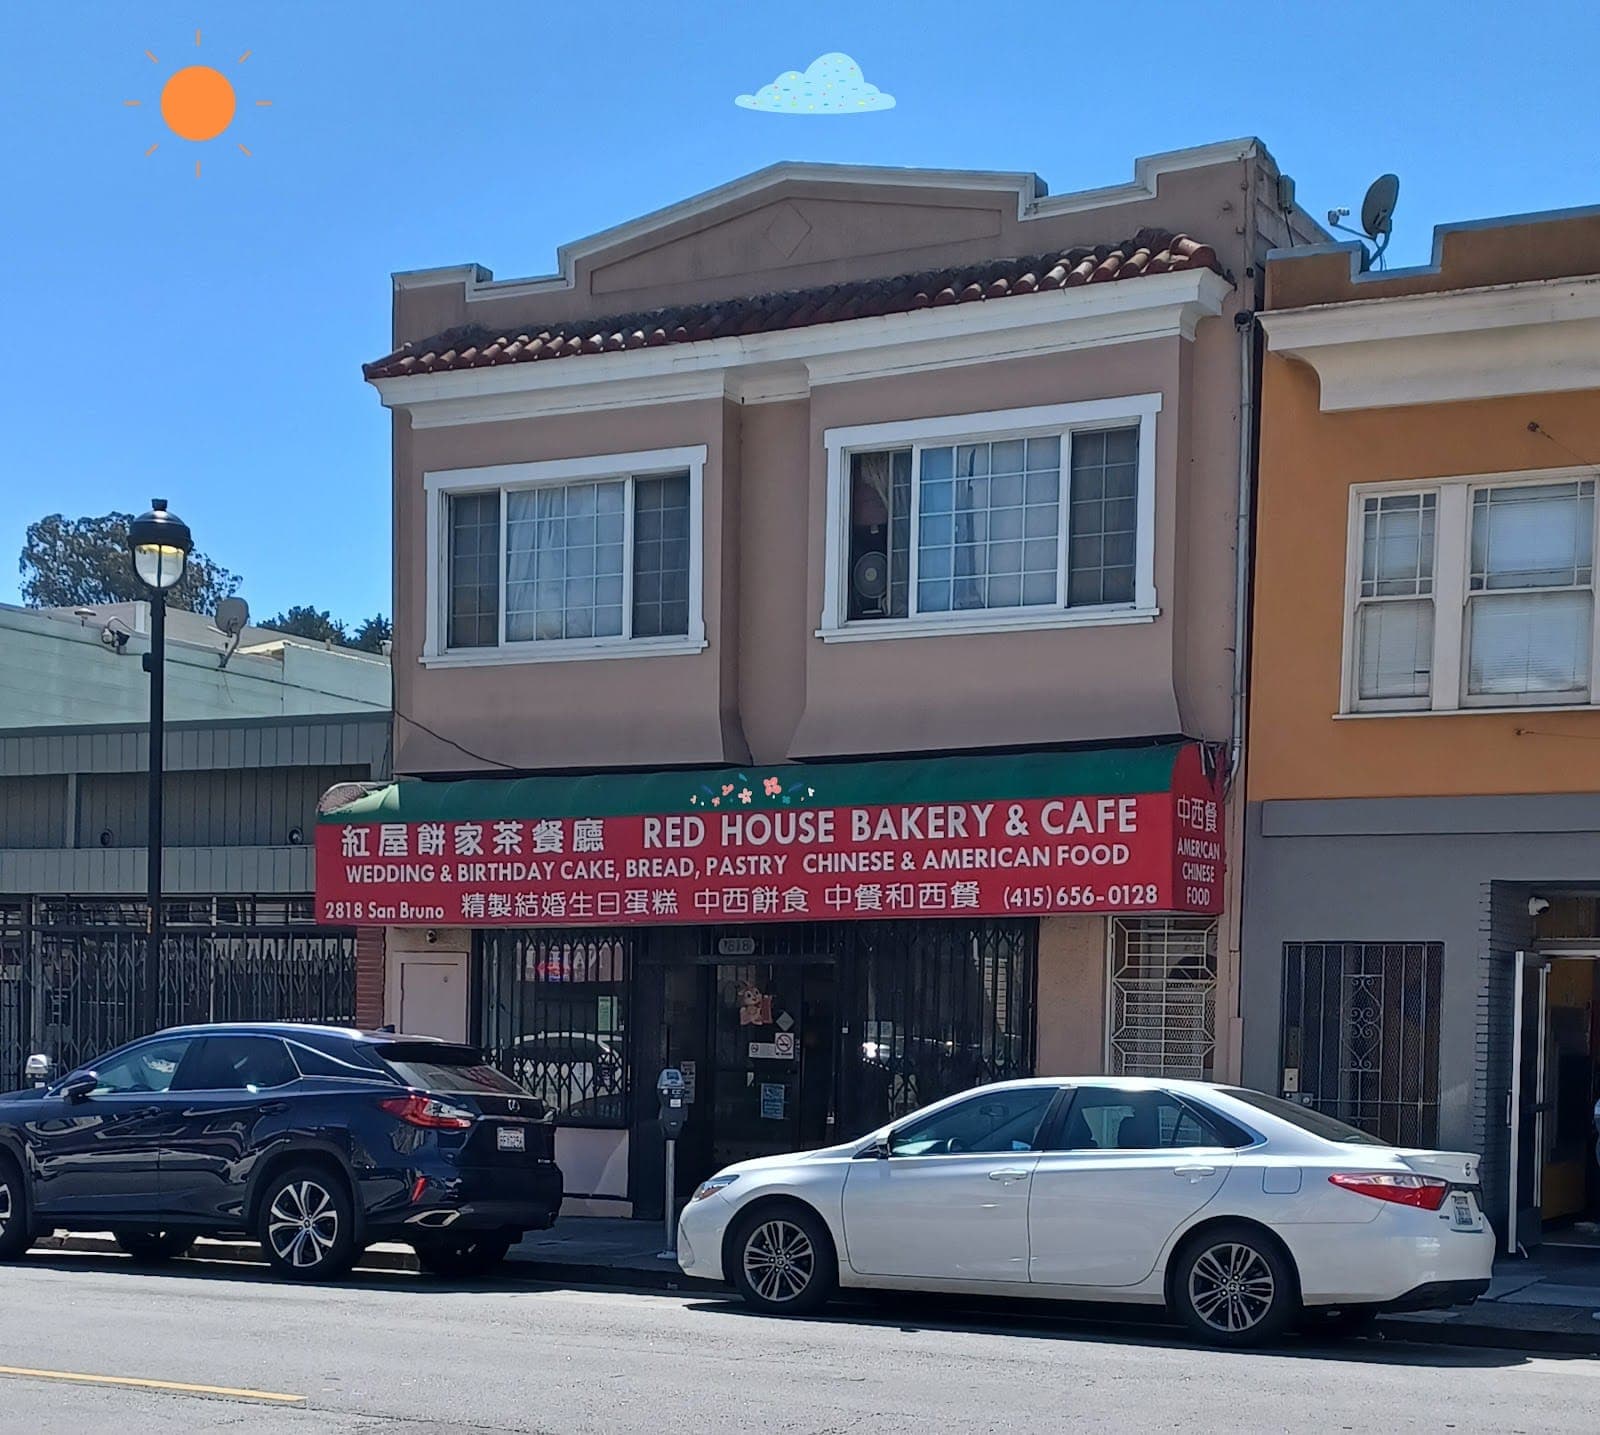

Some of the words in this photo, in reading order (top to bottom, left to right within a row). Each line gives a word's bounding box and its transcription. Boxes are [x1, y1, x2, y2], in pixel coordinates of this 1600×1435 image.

[644, 817, 704, 848] RED
[722, 811, 834, 846] HOUSE
[852, 804, 993, 841] BAKERY
[1006, 805, 1029, 836] &
[1041, 799, 1136, 834] CAFE
[1177, 794, 1217, 833] 中西餐
[342, 818, 604, 857] 紅屋餅家茶餐廳
[1177, 837, 1220, 860] AMERICAN
[347, 865, 434, 883] WEDDING
[440, 865, 451, 881] &
[458, 862, 554, 881] BIRTHDAY
[561, 860, 619, 881] CAKE,
[626, 858, 699, 879] BREAD,
[707, 855, 787, 875] PASTRY
[803, 852, 894, 873] CHINESE
[901, 852, 915, 870] &
[923, 847, 1049, 869] AMERICAN
[1058, 845, 1129, 865] FOOD
[1182, 862, 1215, 883] CHINESE
[326, 902, 362, 918] 2818
[369, 902, 395, 918] San
[400, 902, 443, 918] Bruno
[462, 889, 678, 918] 精製結婚生日蛋糕
[695, 886, 808, 914] 中西餅食
[825, 881, 979, 911] 中餐和西餐
[1186, 887, 1210, 906] FOOD
